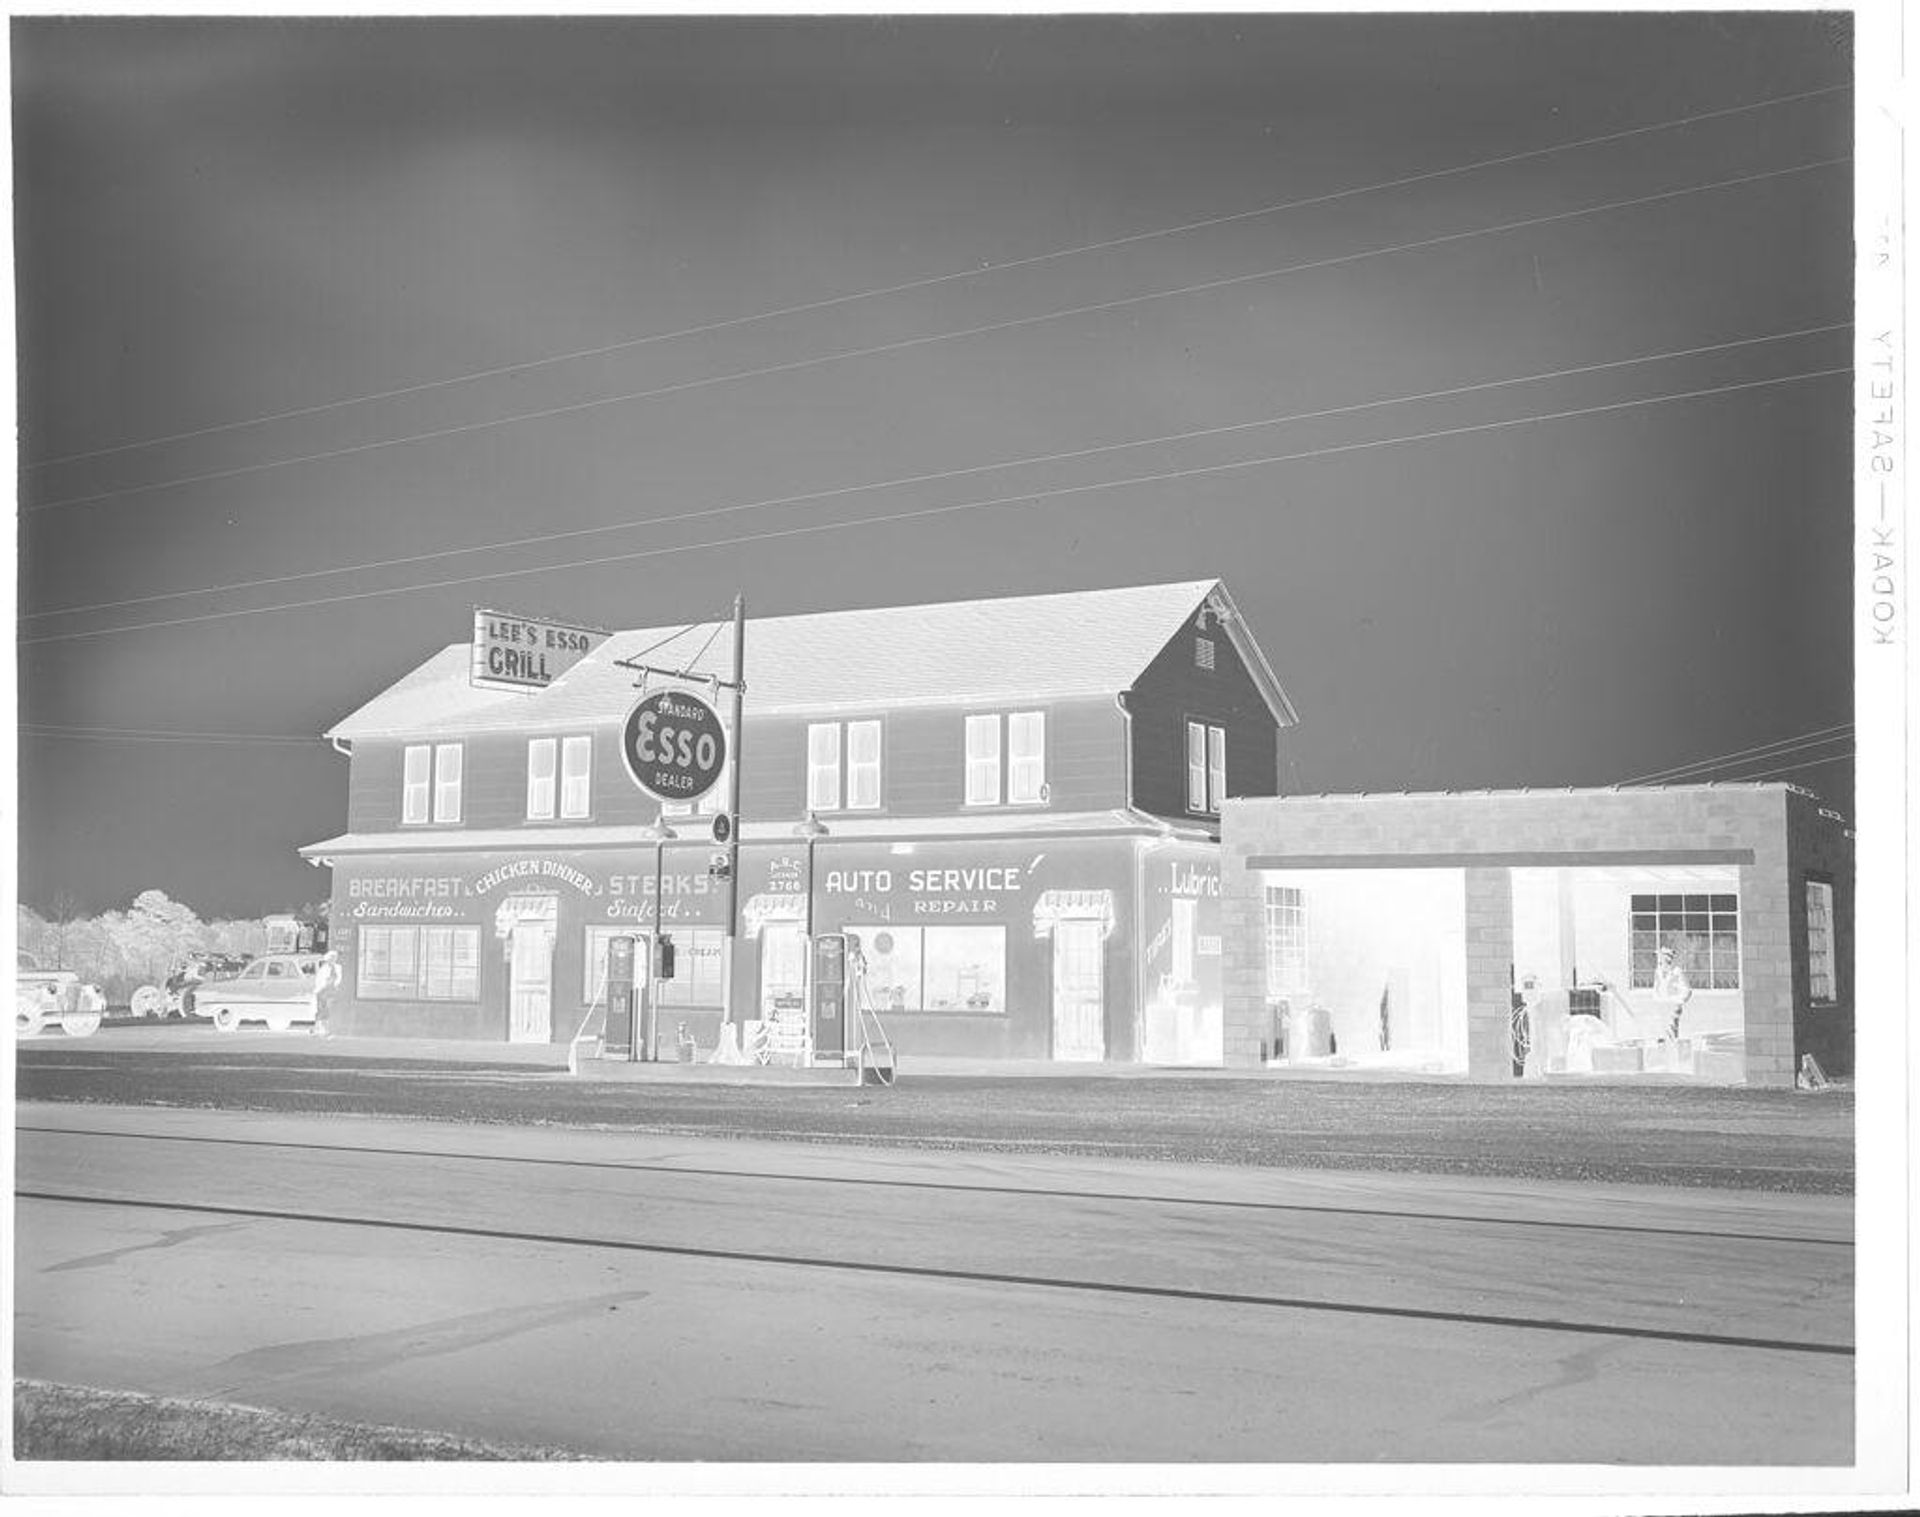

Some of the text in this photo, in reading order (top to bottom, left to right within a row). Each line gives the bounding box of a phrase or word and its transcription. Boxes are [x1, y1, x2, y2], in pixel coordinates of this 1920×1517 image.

[489, 621, 589, 653] LEE'S ESSO
[489, 646, 552, 682] GRILL
[657, 701, 704, 720] STANDARD
[655, 771, 694, 790] DEALER
[349, 878, 463, 898] BREAKFAST
[476, 860, 594, 896] CHICKEN DINNER
[825, 870, 891, 893] AUTO
[914, 900, 998, 914] REPAIR
